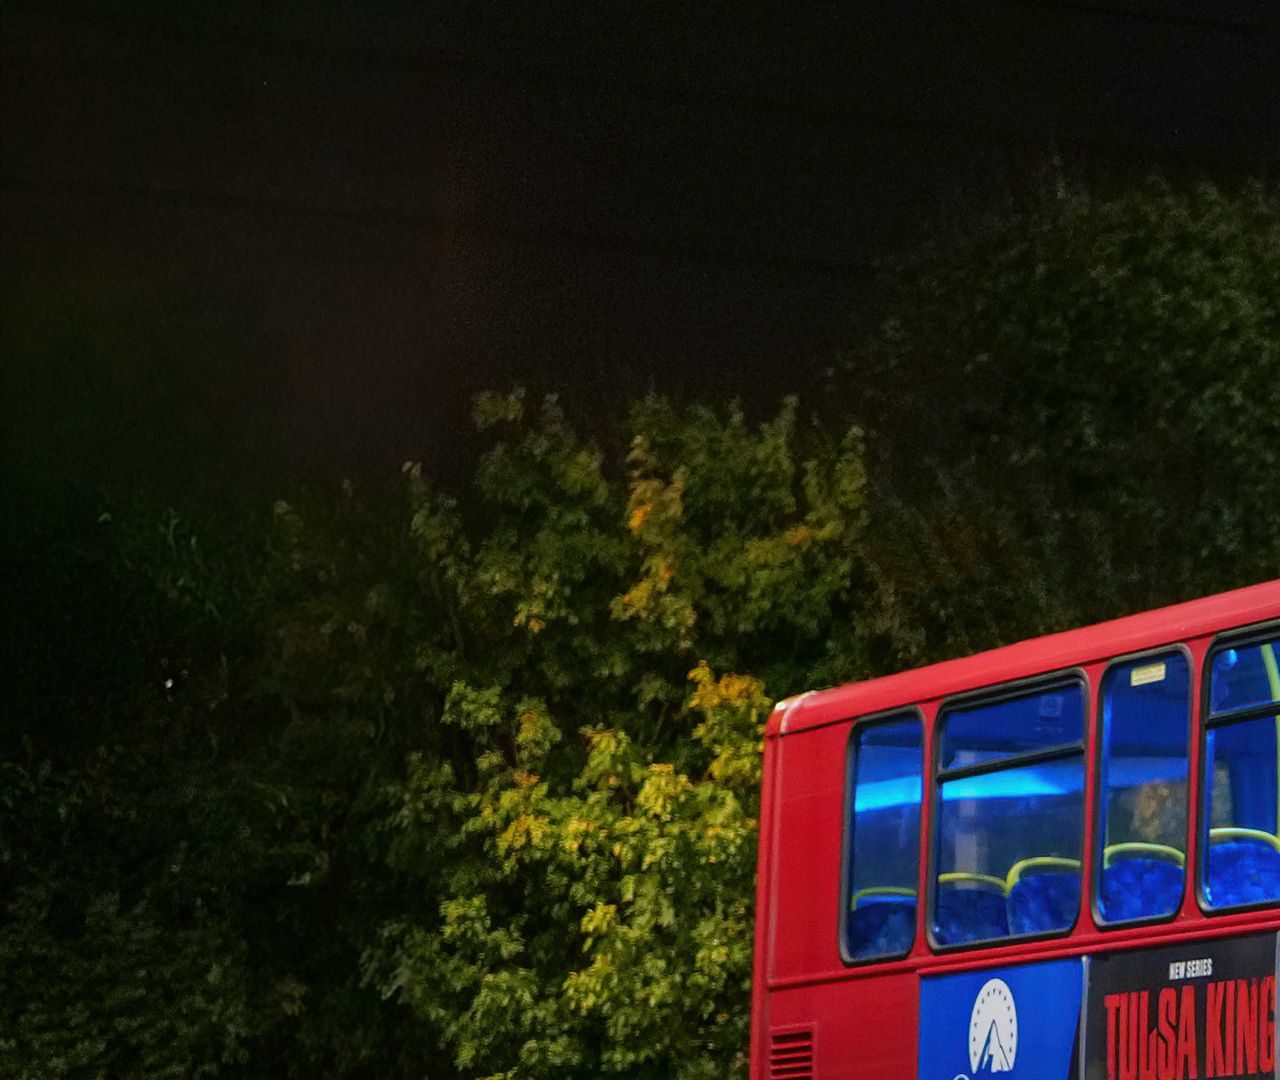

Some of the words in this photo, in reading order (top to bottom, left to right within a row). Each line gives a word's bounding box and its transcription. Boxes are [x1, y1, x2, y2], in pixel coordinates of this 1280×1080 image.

[1169, 961, 1186, 980] NEW
[1186, 958, 1212, 978] SERIES
[1206, 975, 1275, 1078] KING
